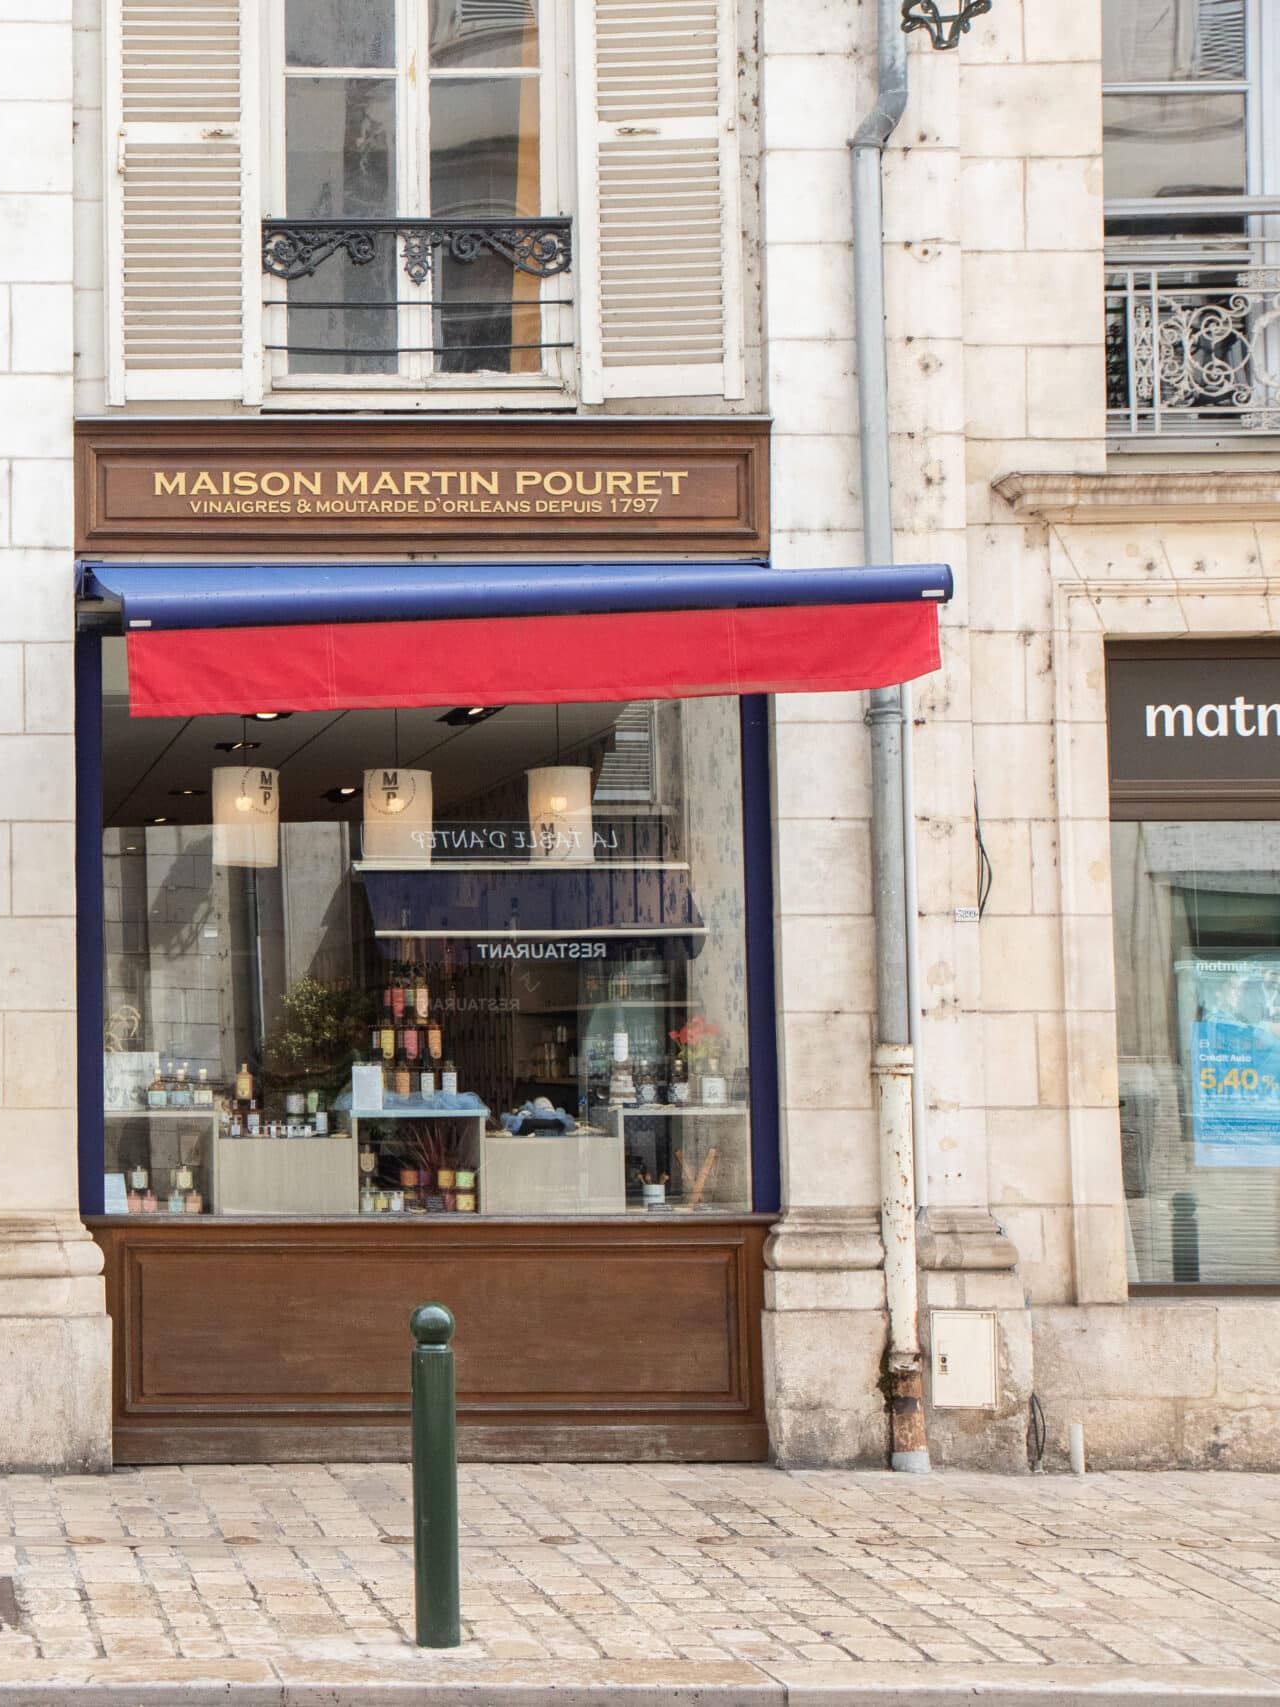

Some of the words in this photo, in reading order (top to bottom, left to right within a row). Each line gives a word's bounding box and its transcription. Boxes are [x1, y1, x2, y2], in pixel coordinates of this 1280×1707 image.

[153, 471, 322, 496] MAISON
[336, 471, 499, 496] MARTIN
[515, 470, 689, 496] POURET
[189, 500, 292, 514] VINAIGRES
[296, 498, 312, 514] &
[316, 500, 420, 514] MOUTARDE
[424, 497, 531, 513] D'ORLEANS
[535, 499, 603, 513] DEPUIS
[610, 498, 659, 513] 1797
[260, 771, 273, 786] M
[382, 771, 399, 786] M
[263, 791, 271, 806] P
[386, 791, 397, 806] P
[1196, 961, 1248, 972] matmut
[1230, 1054, 1252, 1063] Auto
[1200, 1068, 1259, 1093] 5,40
[1262, 1075, 1279, 1089] %
